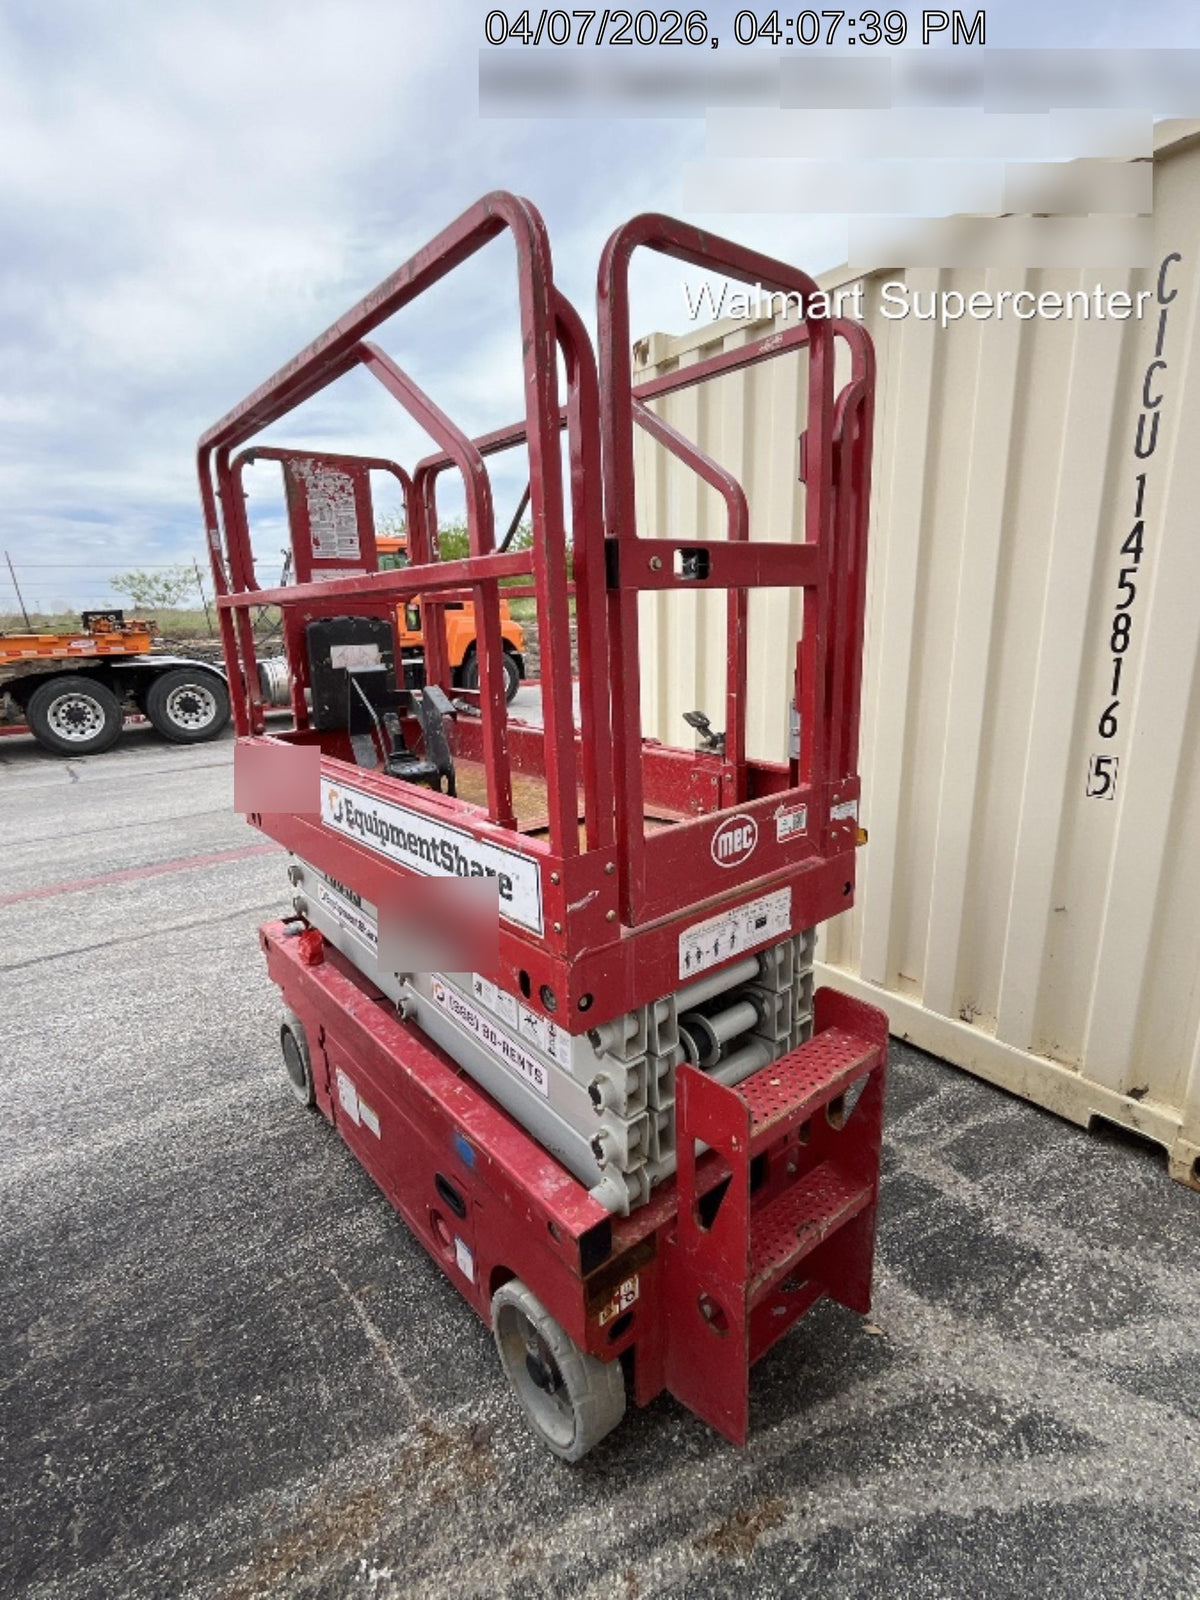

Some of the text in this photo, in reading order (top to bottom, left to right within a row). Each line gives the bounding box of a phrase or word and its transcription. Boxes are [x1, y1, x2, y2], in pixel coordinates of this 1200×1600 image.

[1090, 252, 1182, 797] CICU 145816 5
